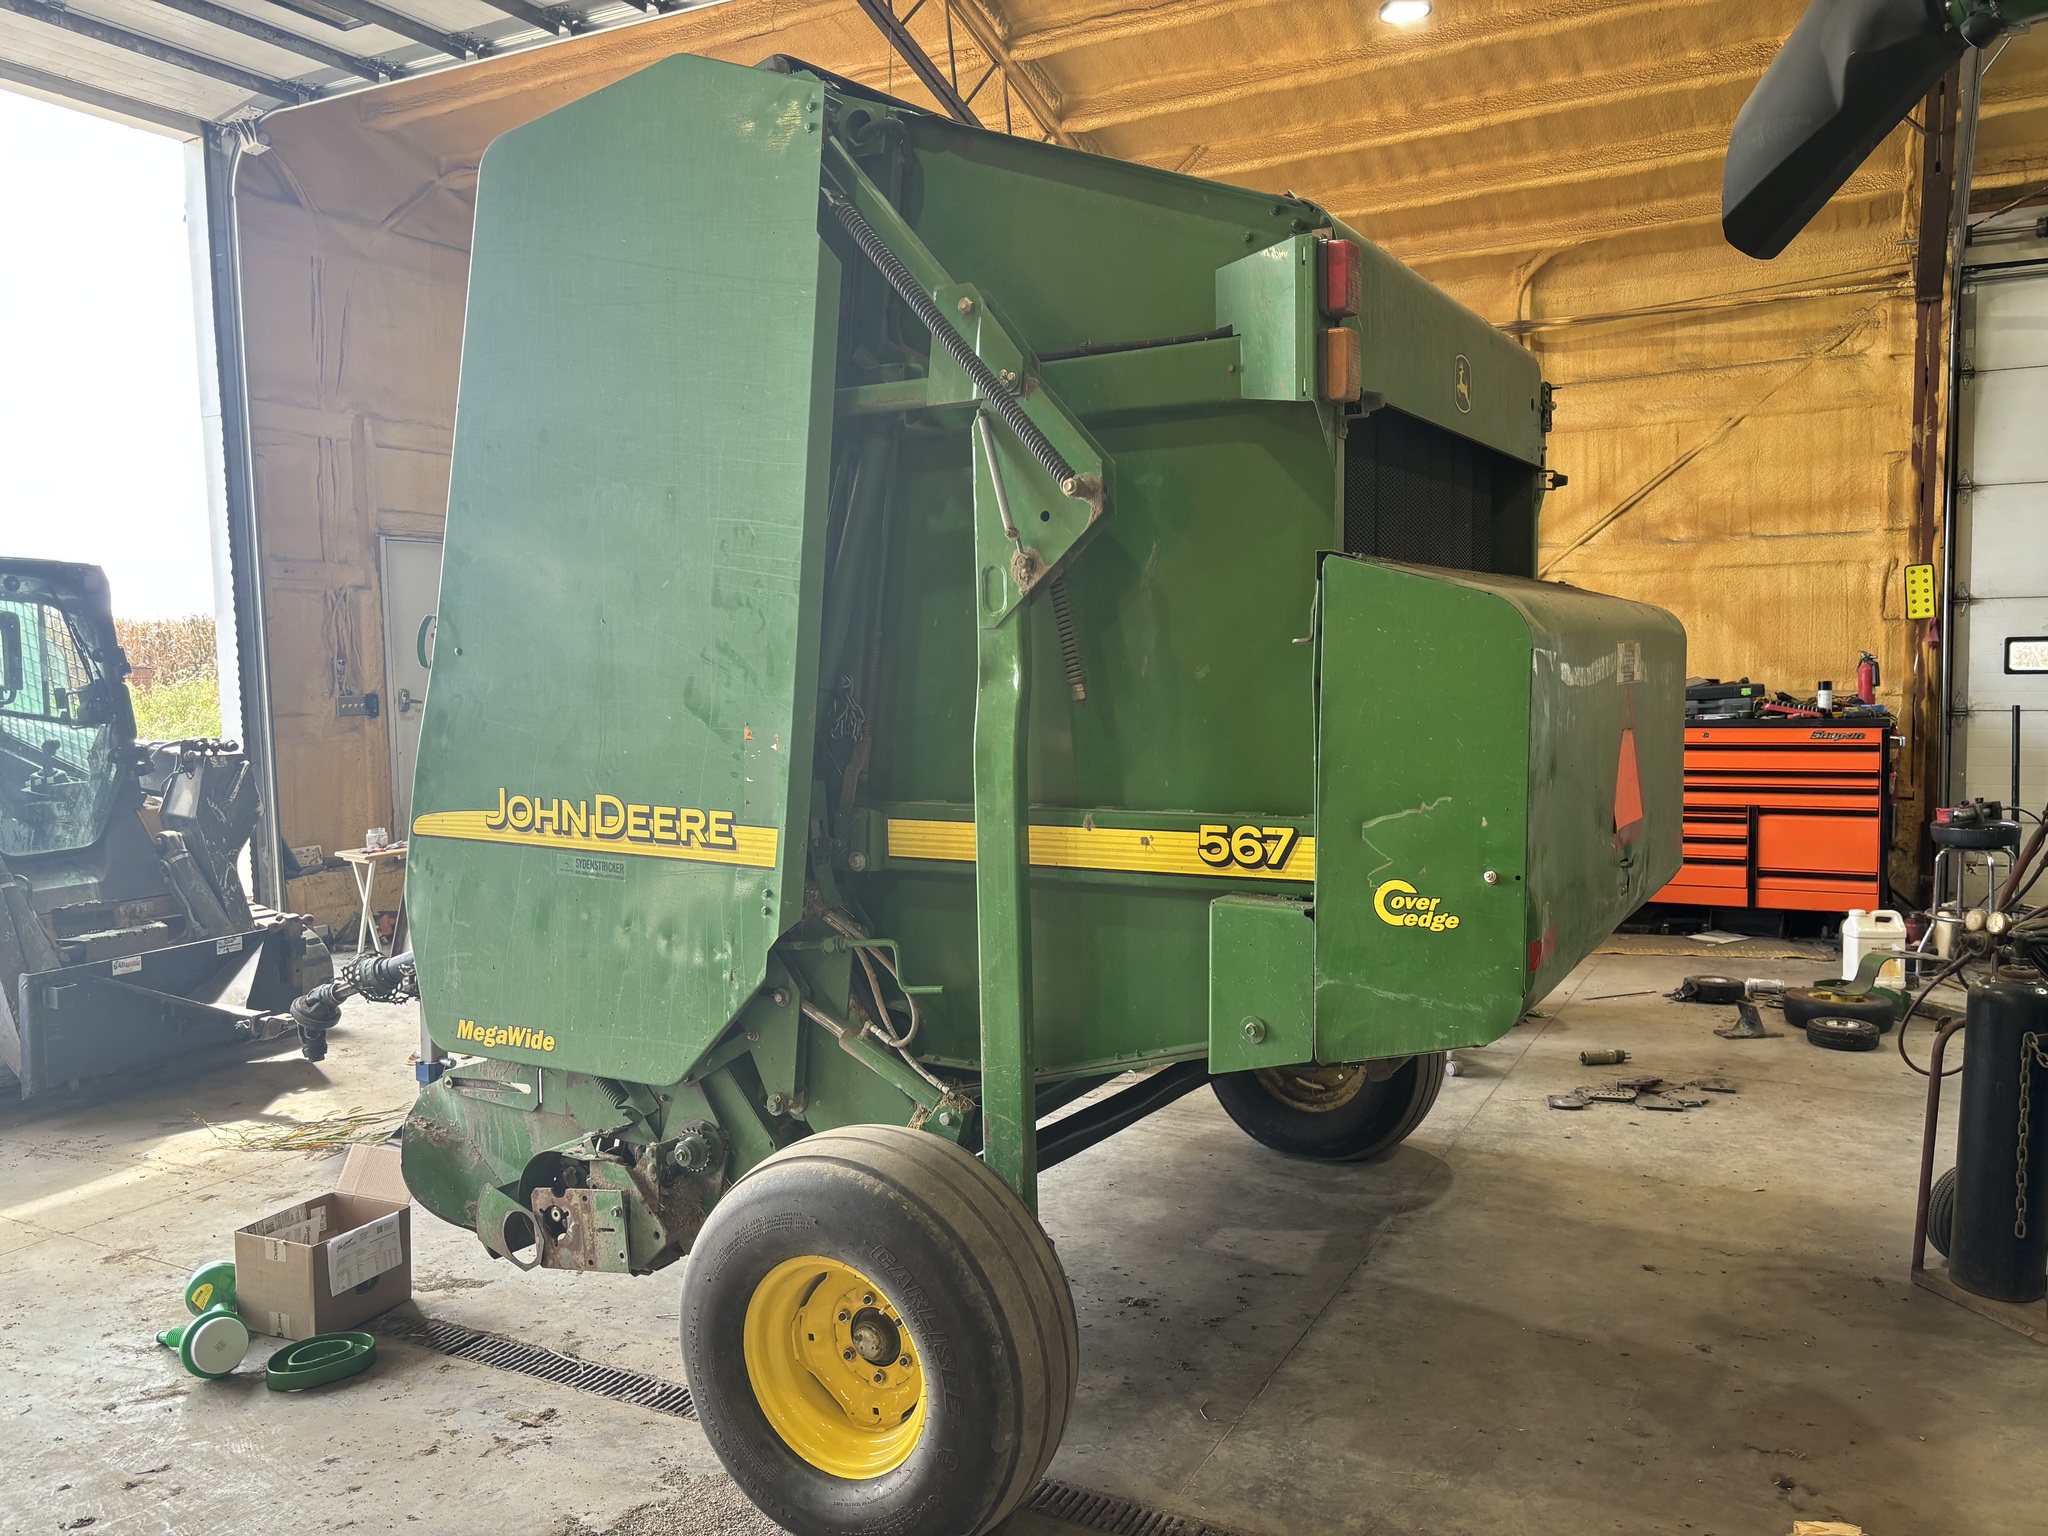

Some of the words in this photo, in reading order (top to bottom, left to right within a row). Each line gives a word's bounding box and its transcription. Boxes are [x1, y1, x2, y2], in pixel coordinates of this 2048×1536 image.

[486, 787, 594, 840] JOHN
[595, 793, 738, 852] DEERE
[575, 858, 625, 874] SYDENSTRICKER
[1198, 823, 1299, 870] 567
[1373, 878, 1441, 927] Cover
[1403, 910, 1460, 932] edge
[456, 1018, 556, 1052] MegaWide
[870, 1245, 963, 1417] CARLISLE
